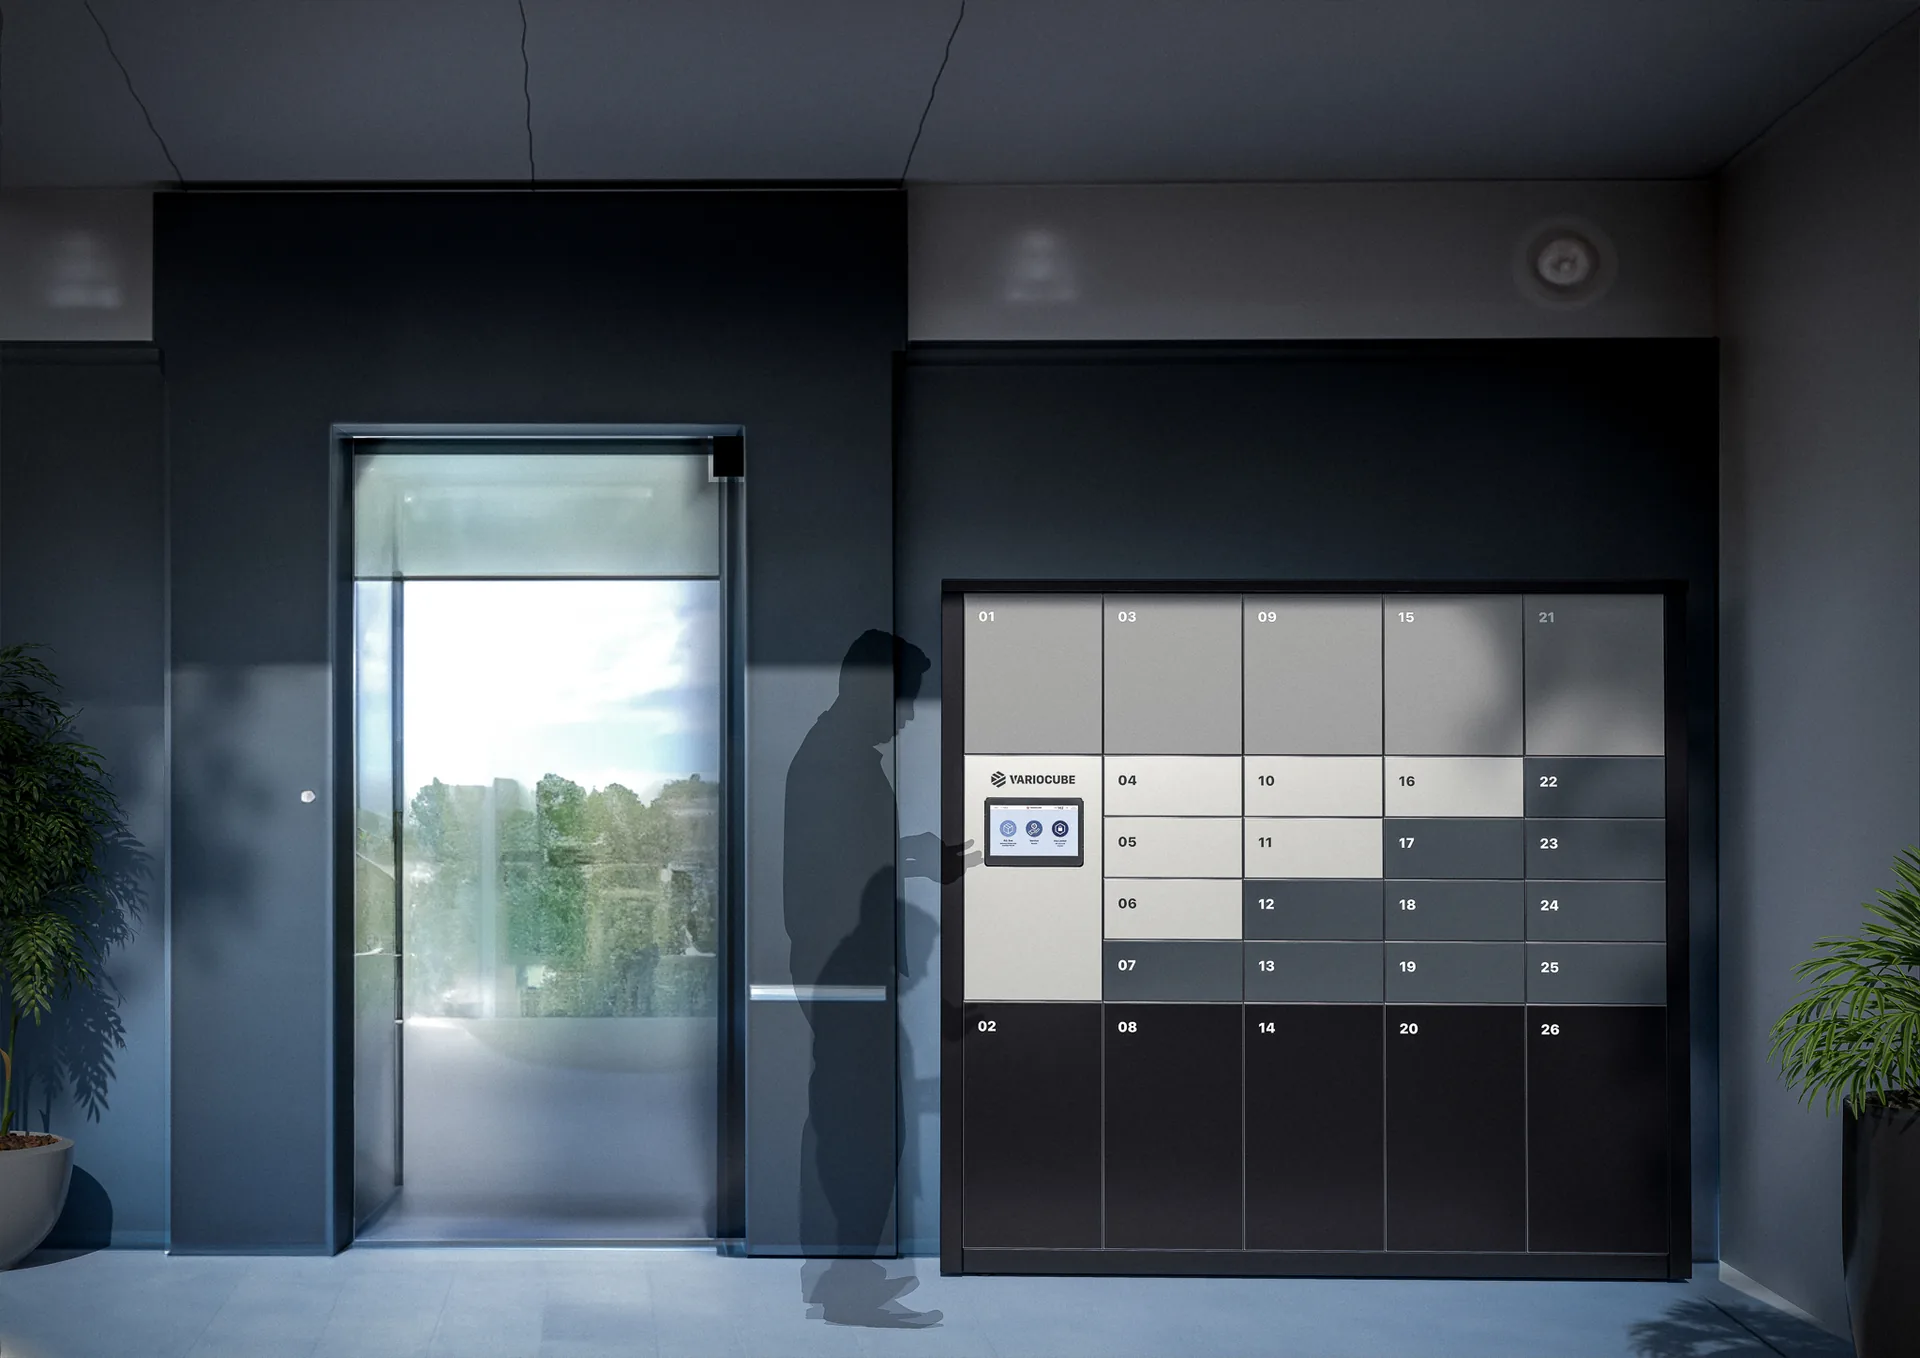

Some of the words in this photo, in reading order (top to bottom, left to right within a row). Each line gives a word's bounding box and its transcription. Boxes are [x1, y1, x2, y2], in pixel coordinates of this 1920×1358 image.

[978, 610, 995, 622] 01
[1117, 611, 1137, 623] 03
[1257, 611, 1277, 623] 09
[1398, 611, 1415, 623] 15
[1538, 611, 1555, 623] 21
[1009, 774, 1076, 785] VARIOCUBE
[1118, 774, 1137, 786] 04
[1258, 775, 1275, 787] 10
[1398, 775, 1416, 787] 16
[1539, 776, 1558, 788] 22
[1118, 836, 1137, 848] 05
[1258, 837, 1272, 848] 11
[1398, 837, 1415, 849] 17
[1539, 837, 1559, 850] 23
[1118, 897, 1137, 910] 06
[1258, 898, 1275, 910] 12
[1399, 898, 1417, 911] 18
[1540, 899, 1559, 912] 24
[1117, 959, 1137, 971] 07
[1258, 960, 1275, 972] 13
[1399, 960, 1417, 973] 19
[1540, 961, 1559, 974] 25
[977, 1020, 997, 1032] 02
[1117, 1021, 1138, 1033] 08
[1258, 1022, 1276, 1034] 14
[1399, 1022, 1419, 1035] 20
[1540, 1023, 1560, 1036] 26
